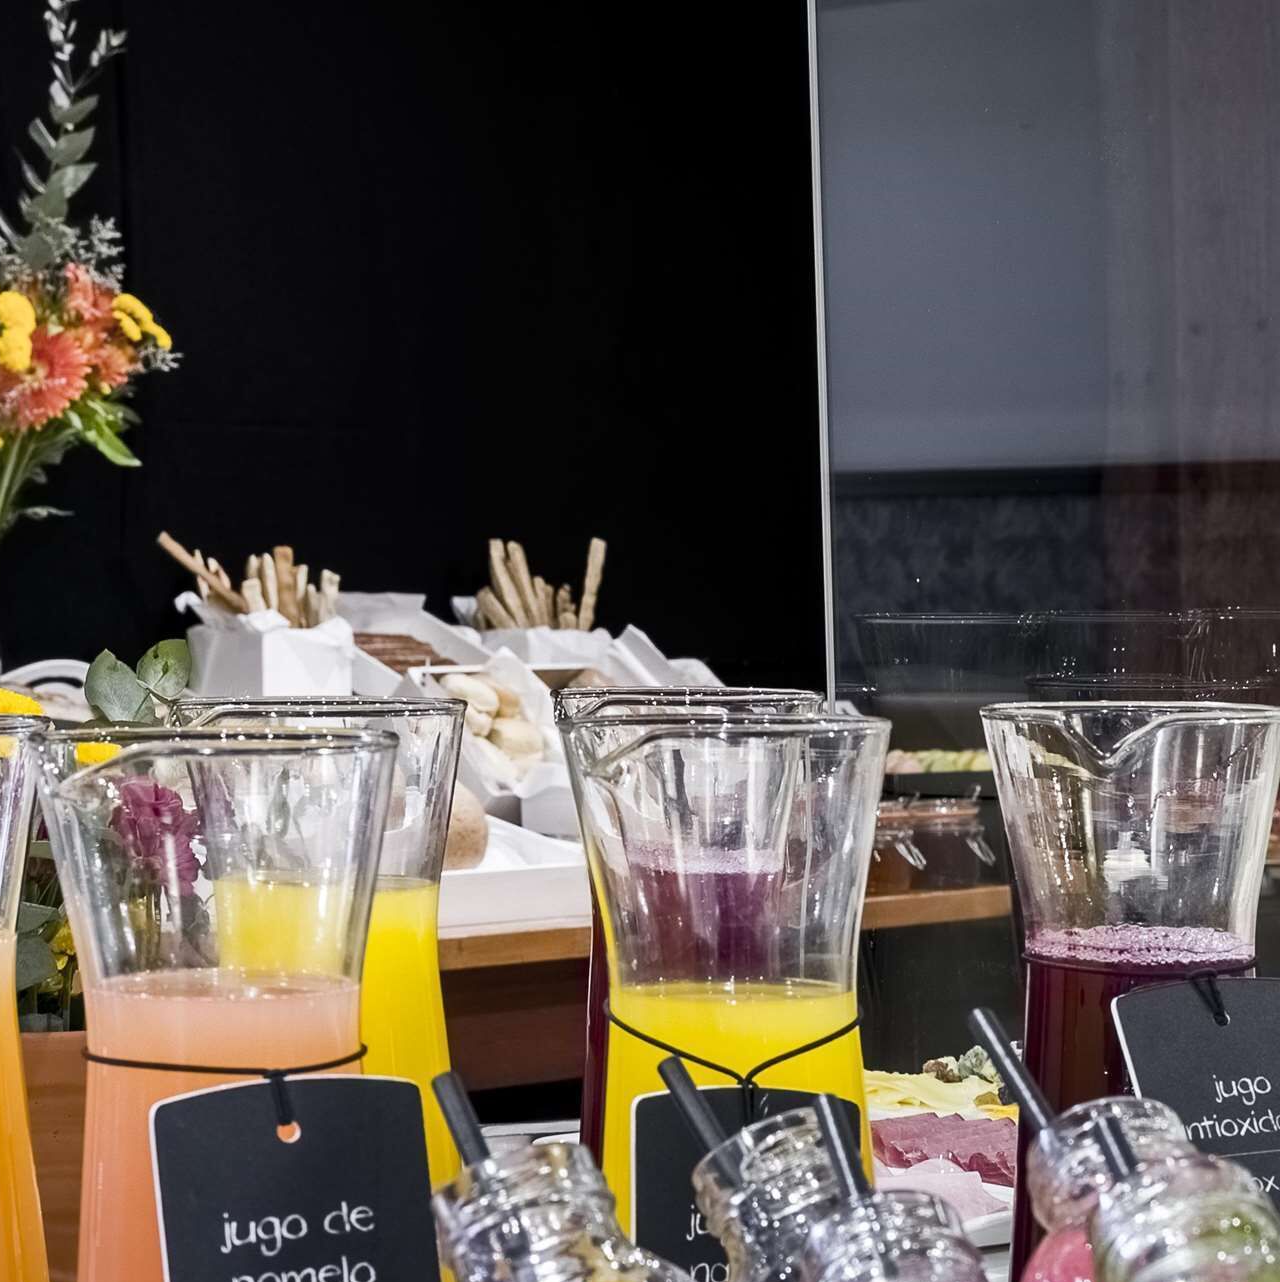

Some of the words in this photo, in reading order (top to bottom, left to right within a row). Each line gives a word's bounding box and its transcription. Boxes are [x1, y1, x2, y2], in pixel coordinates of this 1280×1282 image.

[1213, 1074, 1272, 1106] jugo
[221, 1212, 308, 1257] jugo
[323, 1200, 376, 1234] de
